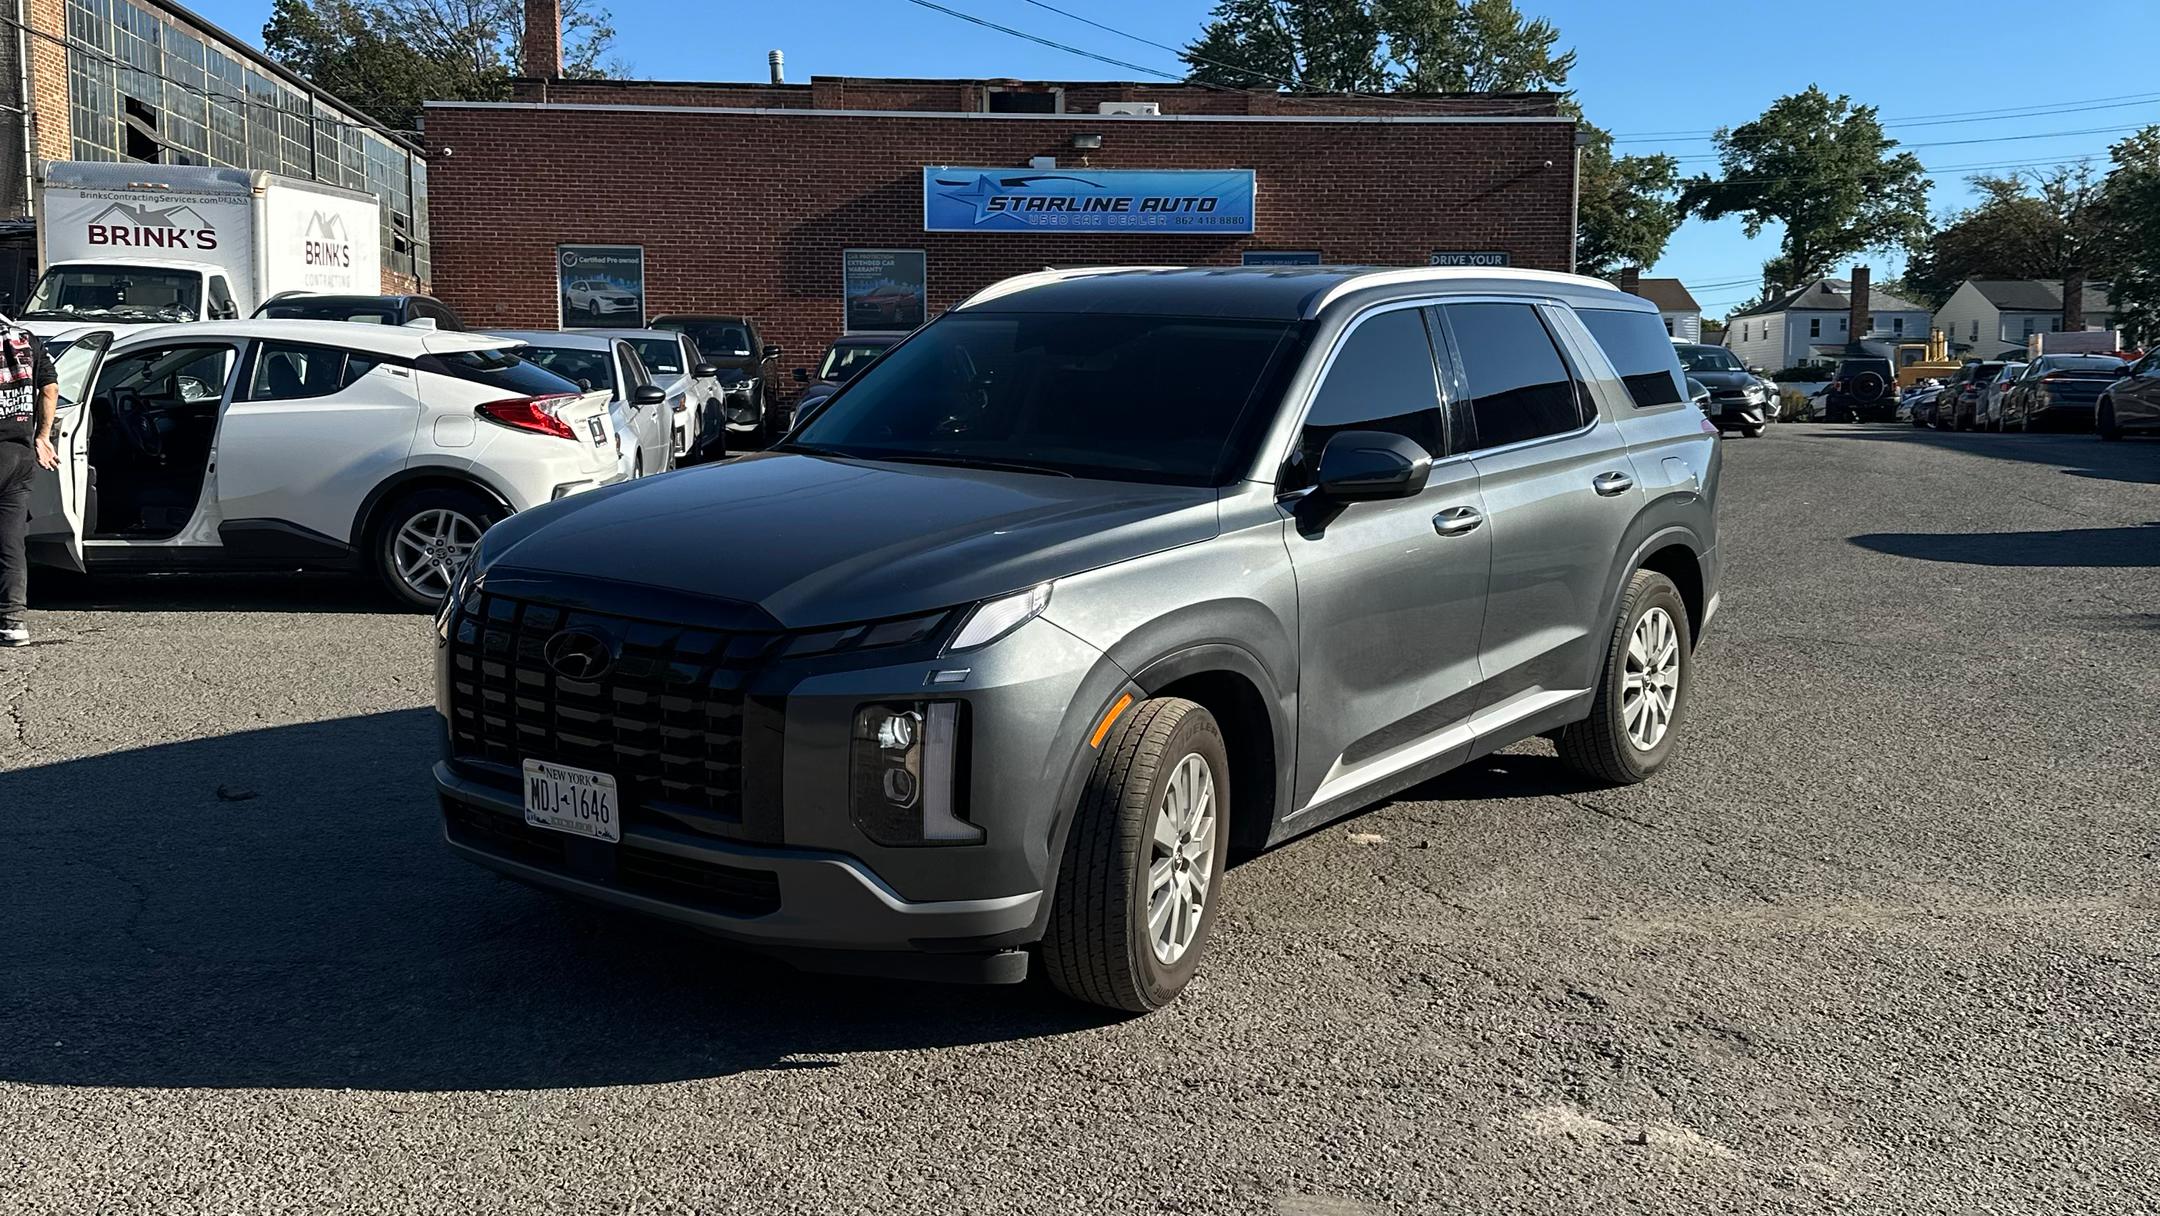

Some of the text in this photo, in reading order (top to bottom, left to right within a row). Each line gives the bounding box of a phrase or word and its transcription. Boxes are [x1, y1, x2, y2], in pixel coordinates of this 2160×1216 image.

[80, 191, 217, 204] BrinksContractingServices.com
[986, 195, 1219, 213] STARLINE AUTO
[1029, 214, 1167, 225] USED CAR DEALER
[1175, 216, 1194, 225] 862
[88, 224, 218, 250] BRINK'S
[305, 240, 350, 268] BRINK'S
[607, 256, 617, 264] Pre
[1431, 255, 1502, 265] DRIVE YOUR
[304, 273, 351, 288] CONTRACTING
[546, 768, 592, 787] NEW YORK
[570, 785, 610, 823] 1646
